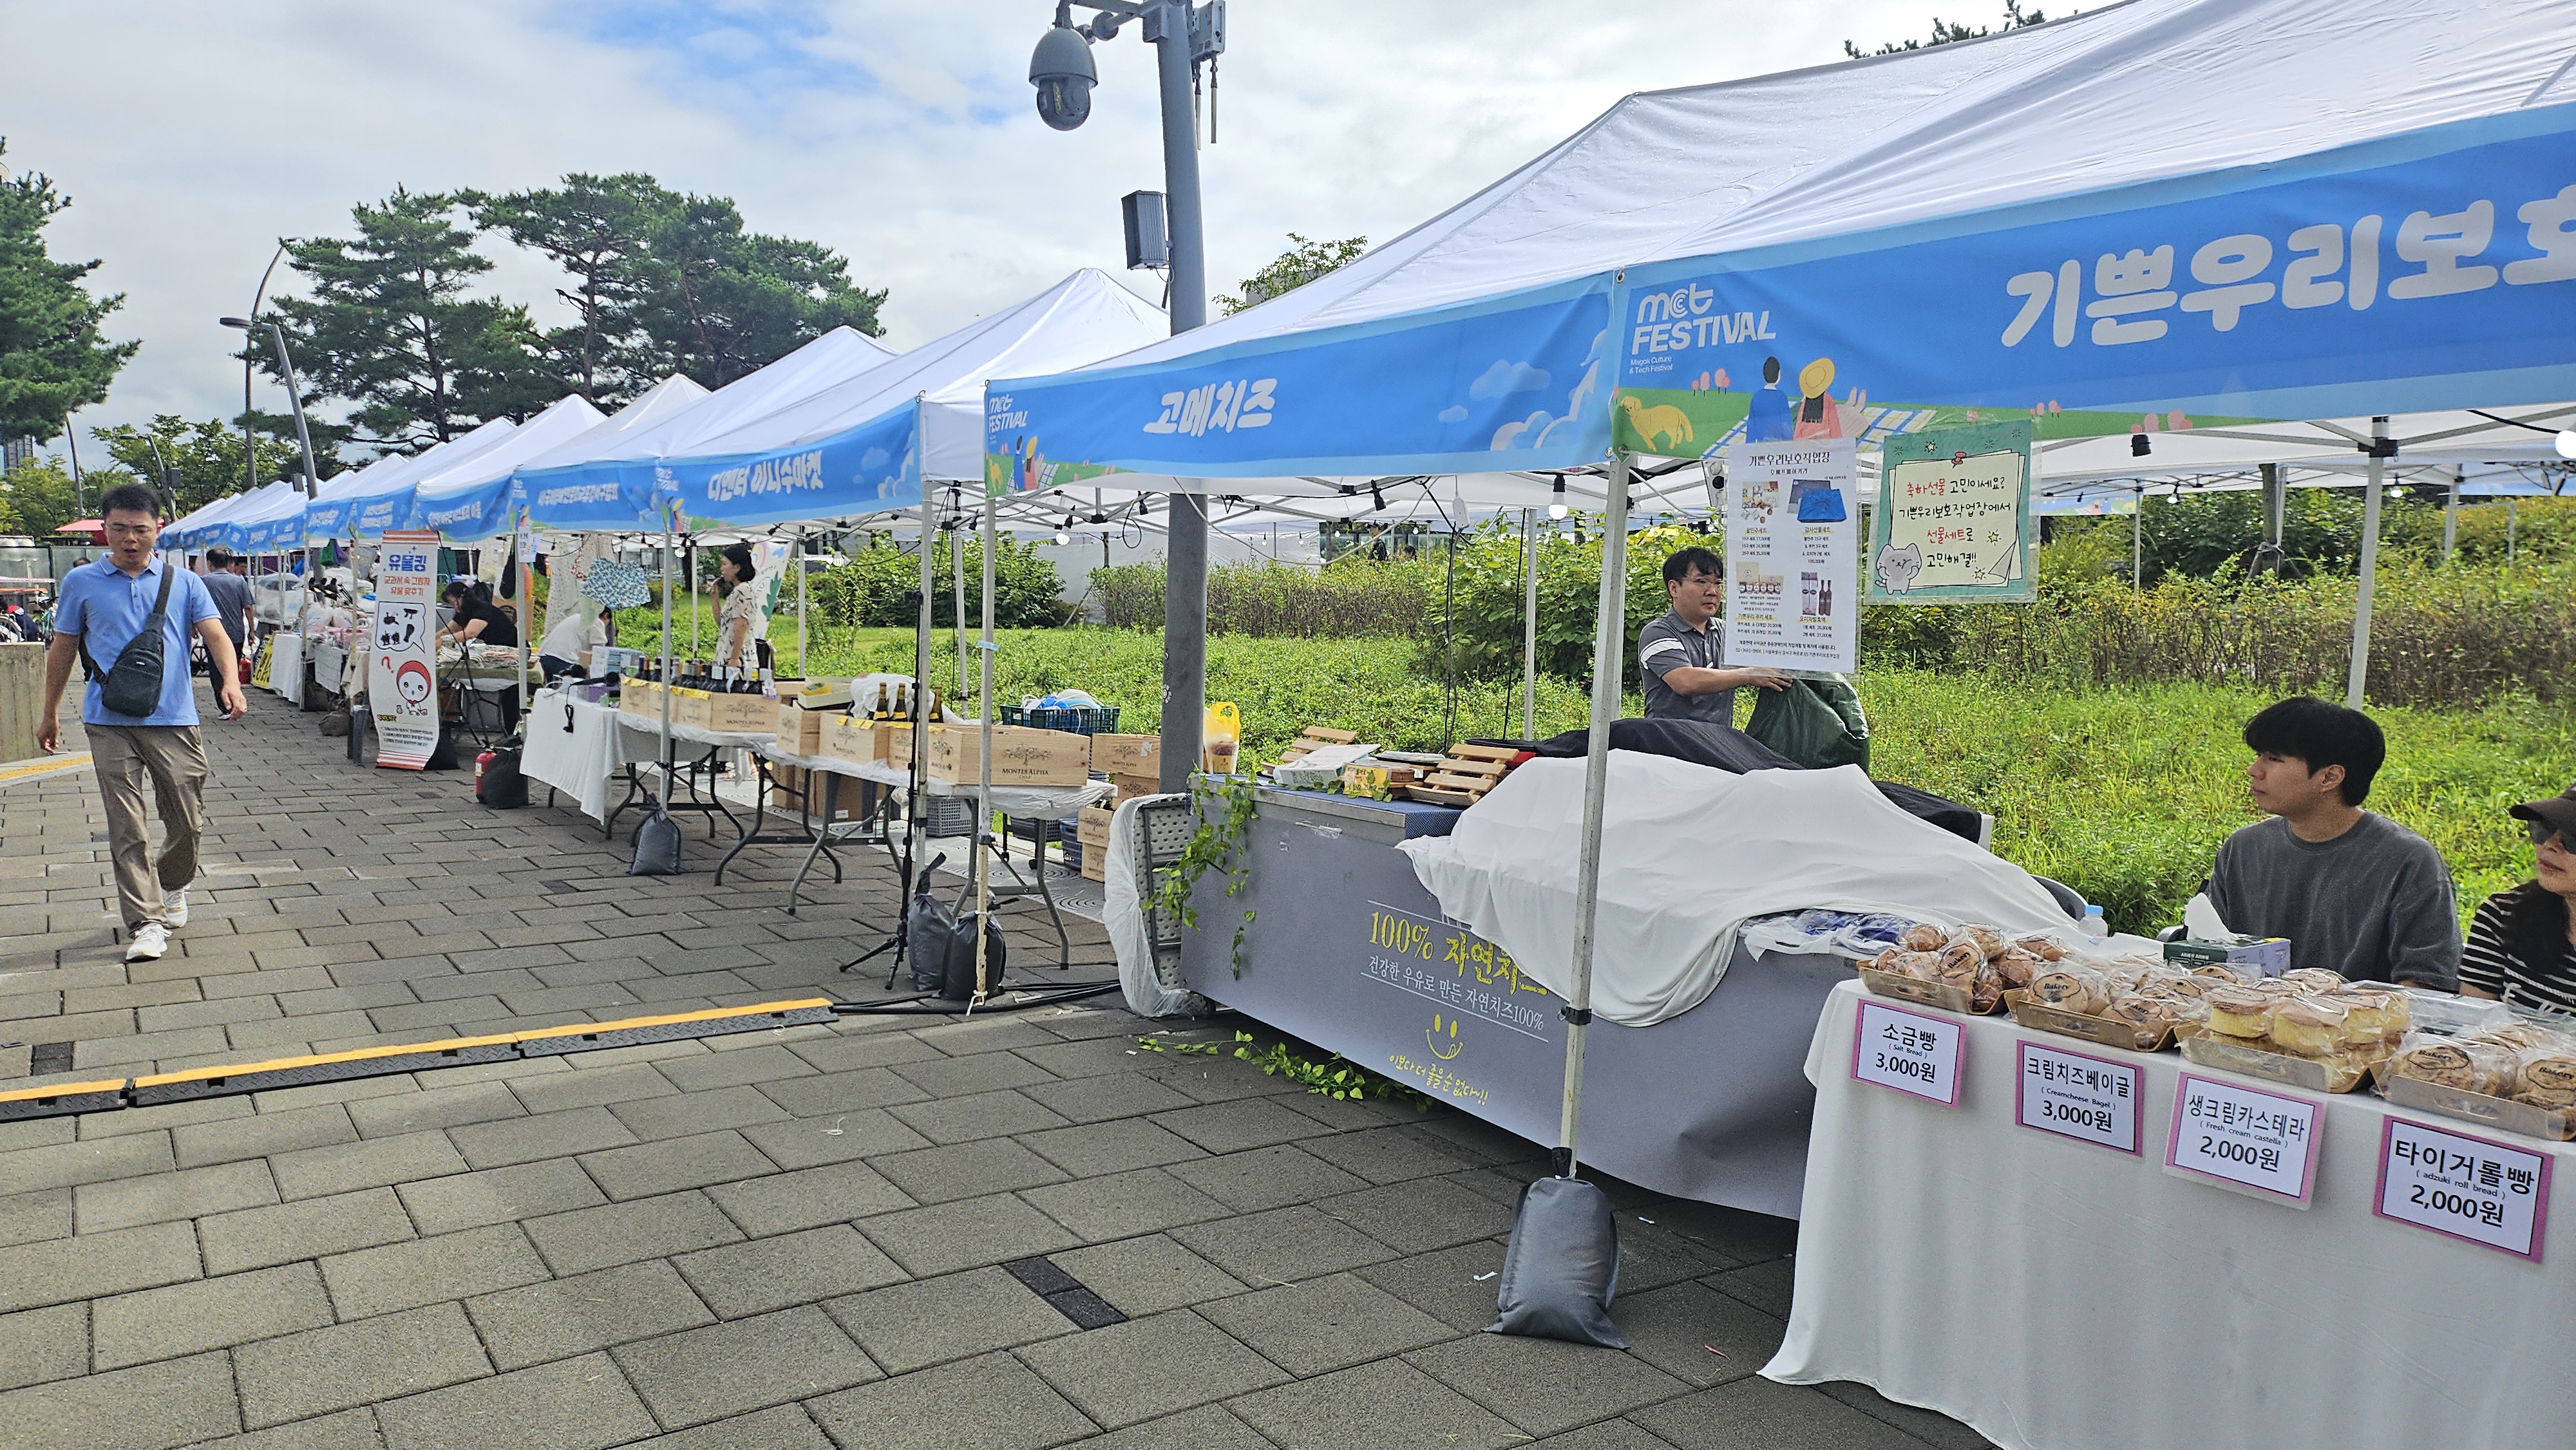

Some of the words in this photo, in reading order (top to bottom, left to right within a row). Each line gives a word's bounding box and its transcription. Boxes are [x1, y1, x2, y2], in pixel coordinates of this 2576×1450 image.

[1632, 310, 1776, 355] FESTIVAL
[989, 411, 1028, 434] FESTIVAL
[1142, 378, 1278, 437] 고메치즈
[1748, 452, 1830, 467] 기쁜우리보호작업장
[1907, 478, 1946, 498] 축하선물
[1950, 476, 2005, 493] 고민이세요?
[1899, 502, 2011, 520] 기쁜우리보호작업장에서
[1927, 527, 1973, 545] 선물세트로
[1927, 552, 1977, 568] 고민해결!!
[384, 576, 402, 584] 교과서
[1369, 911, 1434, 961] 100%
[1368, 956, 1401, 983] 건강한
[1403, 966, 1435, 992] 우유로
[1439, 979, 1461, 1004] 만든
[1466, 988, 1544, 1031] 자연치즈100%
[1882, 1023, 1937, 1052] 소금빵
[1875, 1052, 1936, 1084] 3,000원
[2418, 1050, 2452, 1060] Bakery
[1388, 1055, 1415, 1071] 이보다
[1416, 1065, 1426, 1077] 더
[1426, 1063, 1444, 1089] 좋을
[1443, 1072, 1453, 1092] 수
[2027, 1057, 2130, 1098] 크림치즈베이글
[2539, 1066, 2575, 1080] Bakery
[2042, 1100, 2113, 1133] 3,000원
[2189, 1093, 2306, 1143] 생크림카스테라
[2228, 1129, 2251, 1138] cream
[2199, 1135, 2281, 1174] 2,000원
[2394, 1140, 2536, 1196] 타이거롤빵
[2454, 1181, 2468, 1189] roll
[2410, 1183, 2505, 1229] 2,000원
